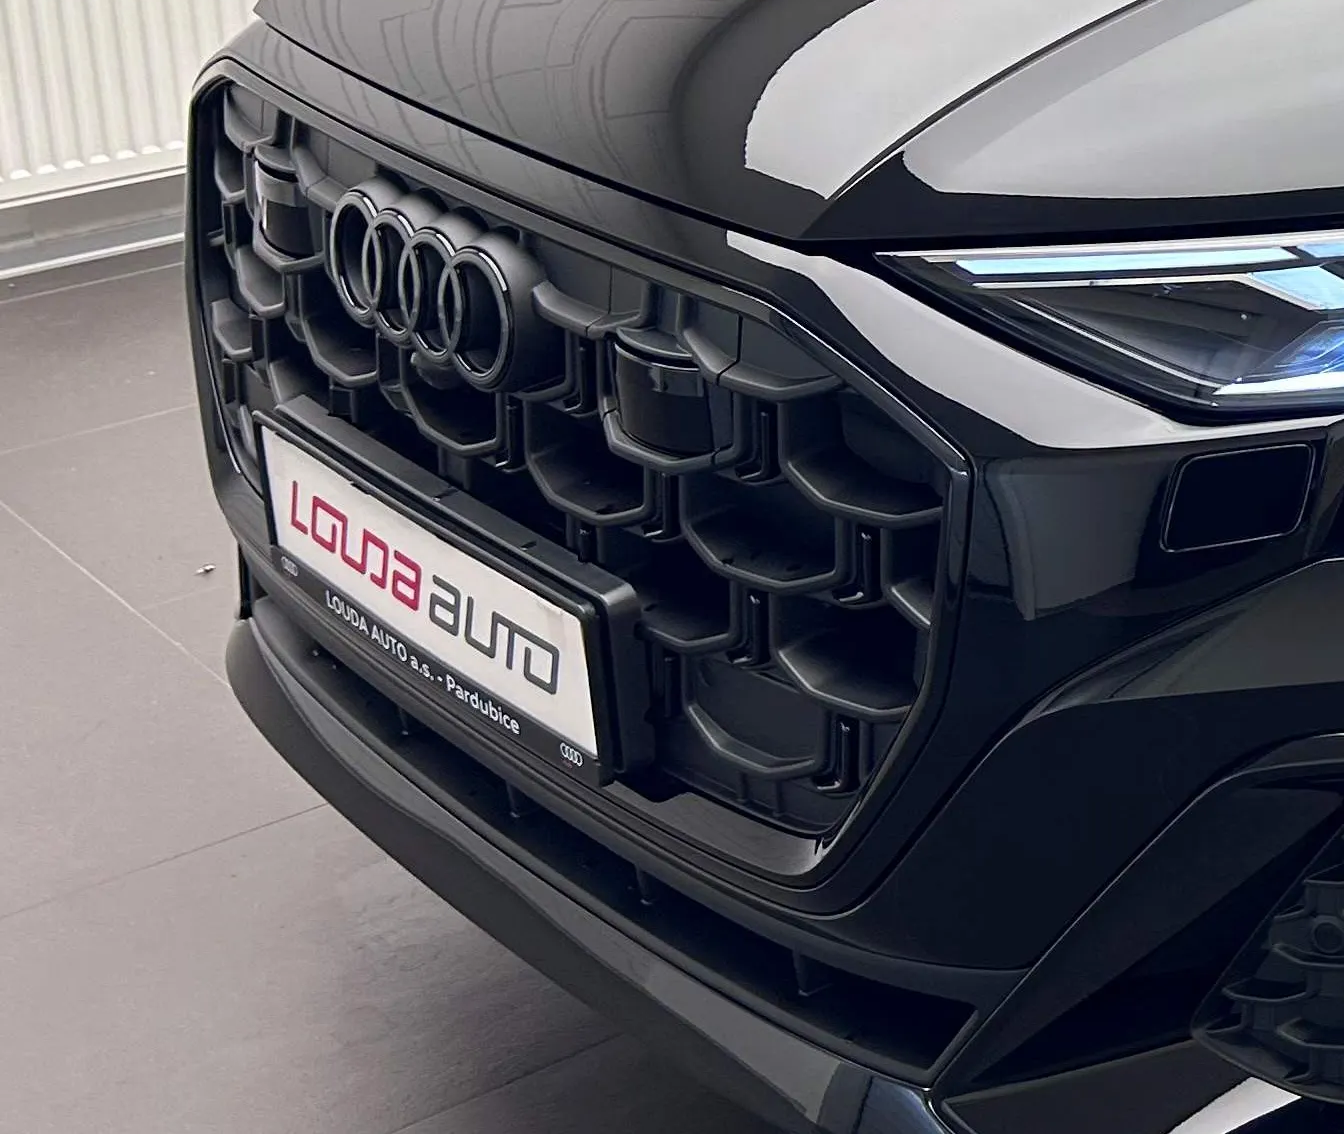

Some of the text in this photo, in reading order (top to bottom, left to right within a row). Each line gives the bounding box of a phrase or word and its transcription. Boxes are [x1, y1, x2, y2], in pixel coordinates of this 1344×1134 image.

[325, 589, 369, 635] LOUDA
[371, 628, 408, 662] AUTO
[409, 653, 435, 681] a.s.
[445, 674, 521, 735] Pardubice
